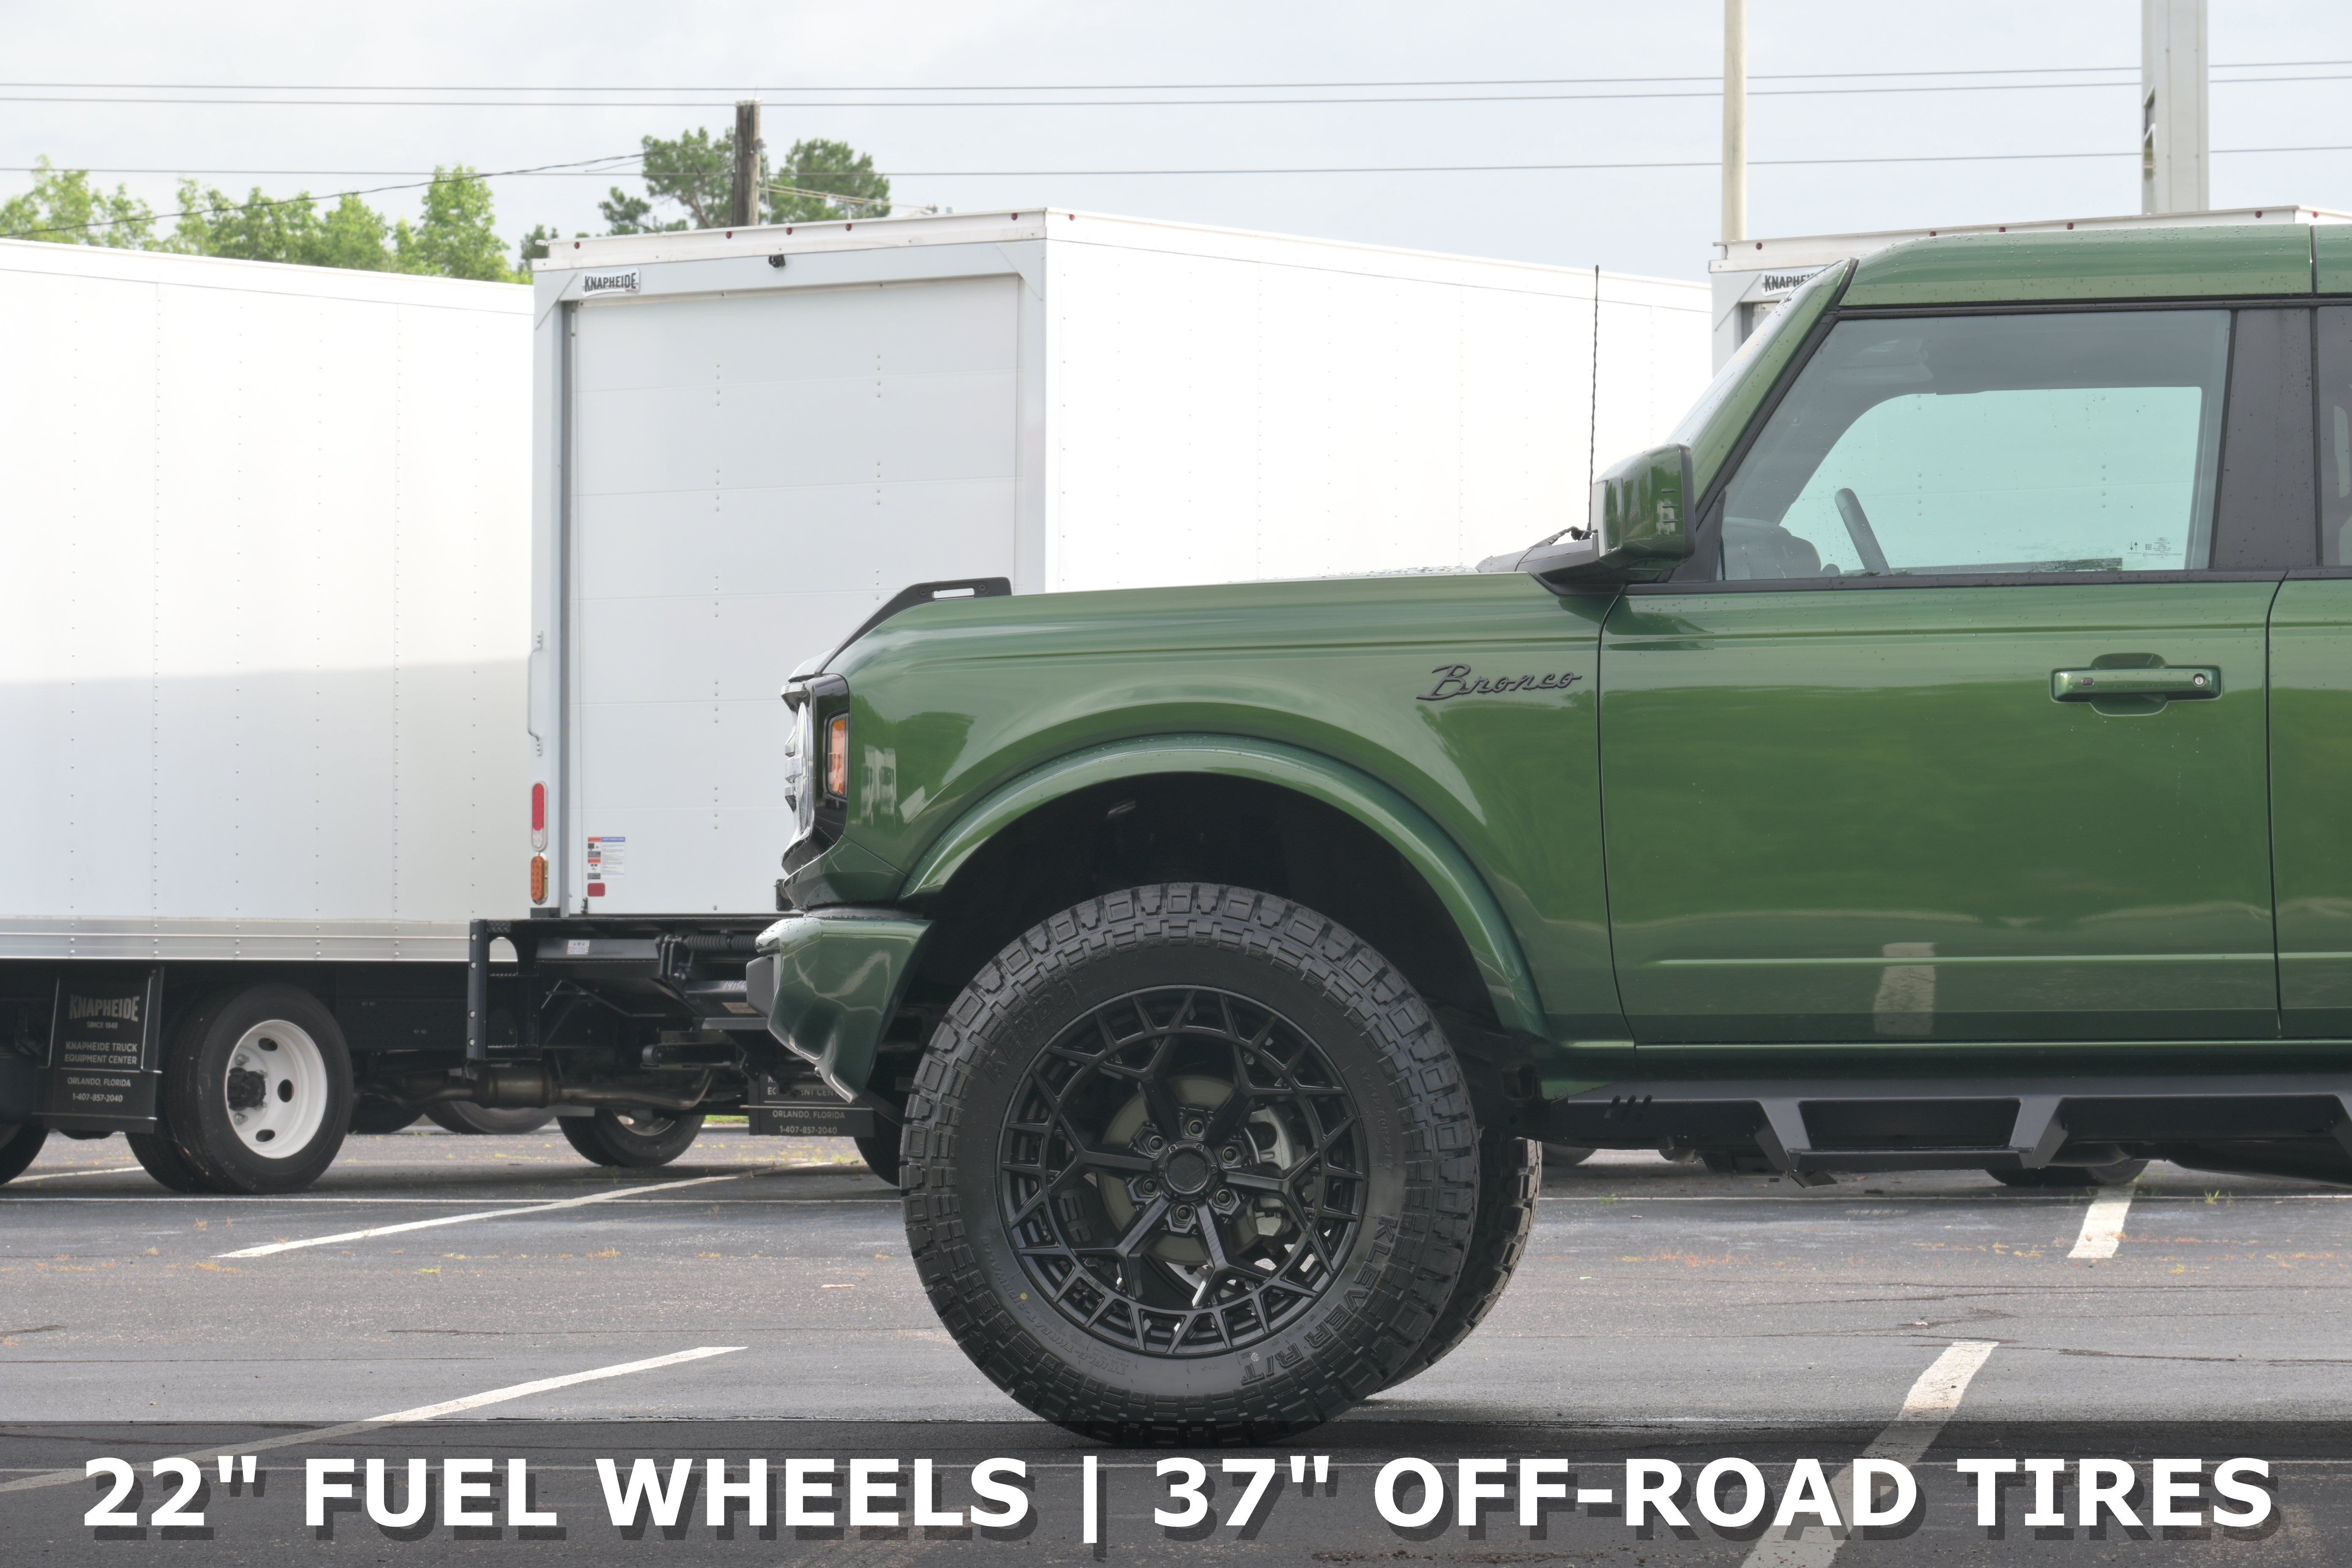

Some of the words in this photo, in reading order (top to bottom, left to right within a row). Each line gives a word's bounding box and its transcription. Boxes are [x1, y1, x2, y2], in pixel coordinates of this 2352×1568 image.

[585, 272, 636, 292] KNAPHEIDE
[1765, 273, 1816, 292] KNAPHE
[1416, 663, 1582, 701] Bronco
[69, 994, 140, 1022] KNAPHEIDE
[65, 1041, 109, 1051] KNAPHEIDE
[112, 1043, 137, 1052] TRUCK
[65, 1054, 106, 1063] EQUIPMENT
[108, 1055, 137, 1064] CENTER
[67, 1077, 101, 1086] ORLANDO,
[103, 1078, 131, 1087] FLORIDA
[72, 1093, 123, 1102] 1-407-857-2040
[773, 1110, 811, 1119] ORLANDO,
[780, 1125, 838, 1134] 1-407-857-2040
[1079, 1269, 1108, 1296] FUEL
[1304, 1214, 1398, 1349] KLEVER
[1241, 1342, 1304, 1386] R/T
